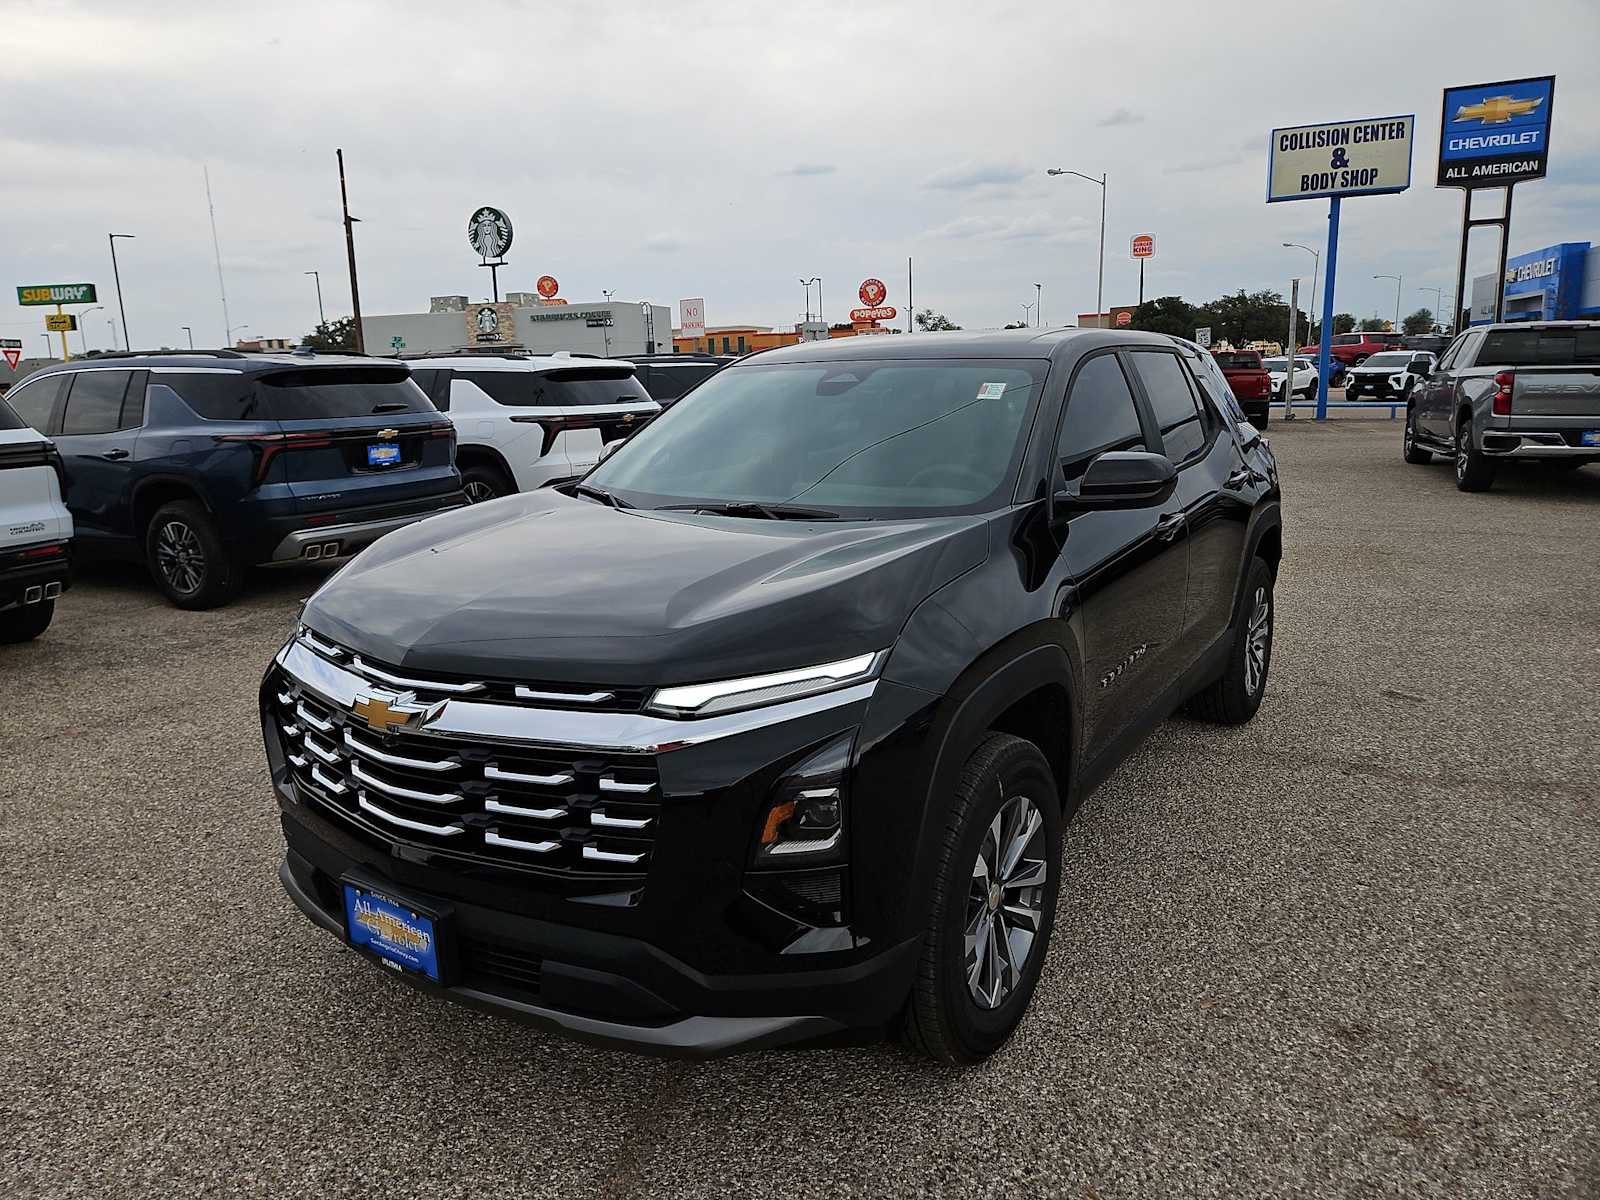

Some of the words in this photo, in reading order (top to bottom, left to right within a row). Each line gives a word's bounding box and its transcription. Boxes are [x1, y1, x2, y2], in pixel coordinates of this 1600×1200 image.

[1280, 127, 1350, 152] COLLISION
[1353, 121, 1406, 144] CENTER
[1449, 131, 1540, 151] CHEVROLET
[1330, 147, 1350, 170] &
[1300, 171, 1338, 192] BODY
[1340, 168, 1379, 188] SHOP
[1445, 166, 1469, 179] ALL
[1472, 160, 1539, 177] AMERICAN
[1517, 257, 1556, 282] CHEVROLET
[22, 286, 88, 303] SUBWAY
[686, 307, 698, 317] NO
[681, 322, 704, 330] PARKING
[354, 899, 371, 917] All
[375, 907, 431, 942] American
